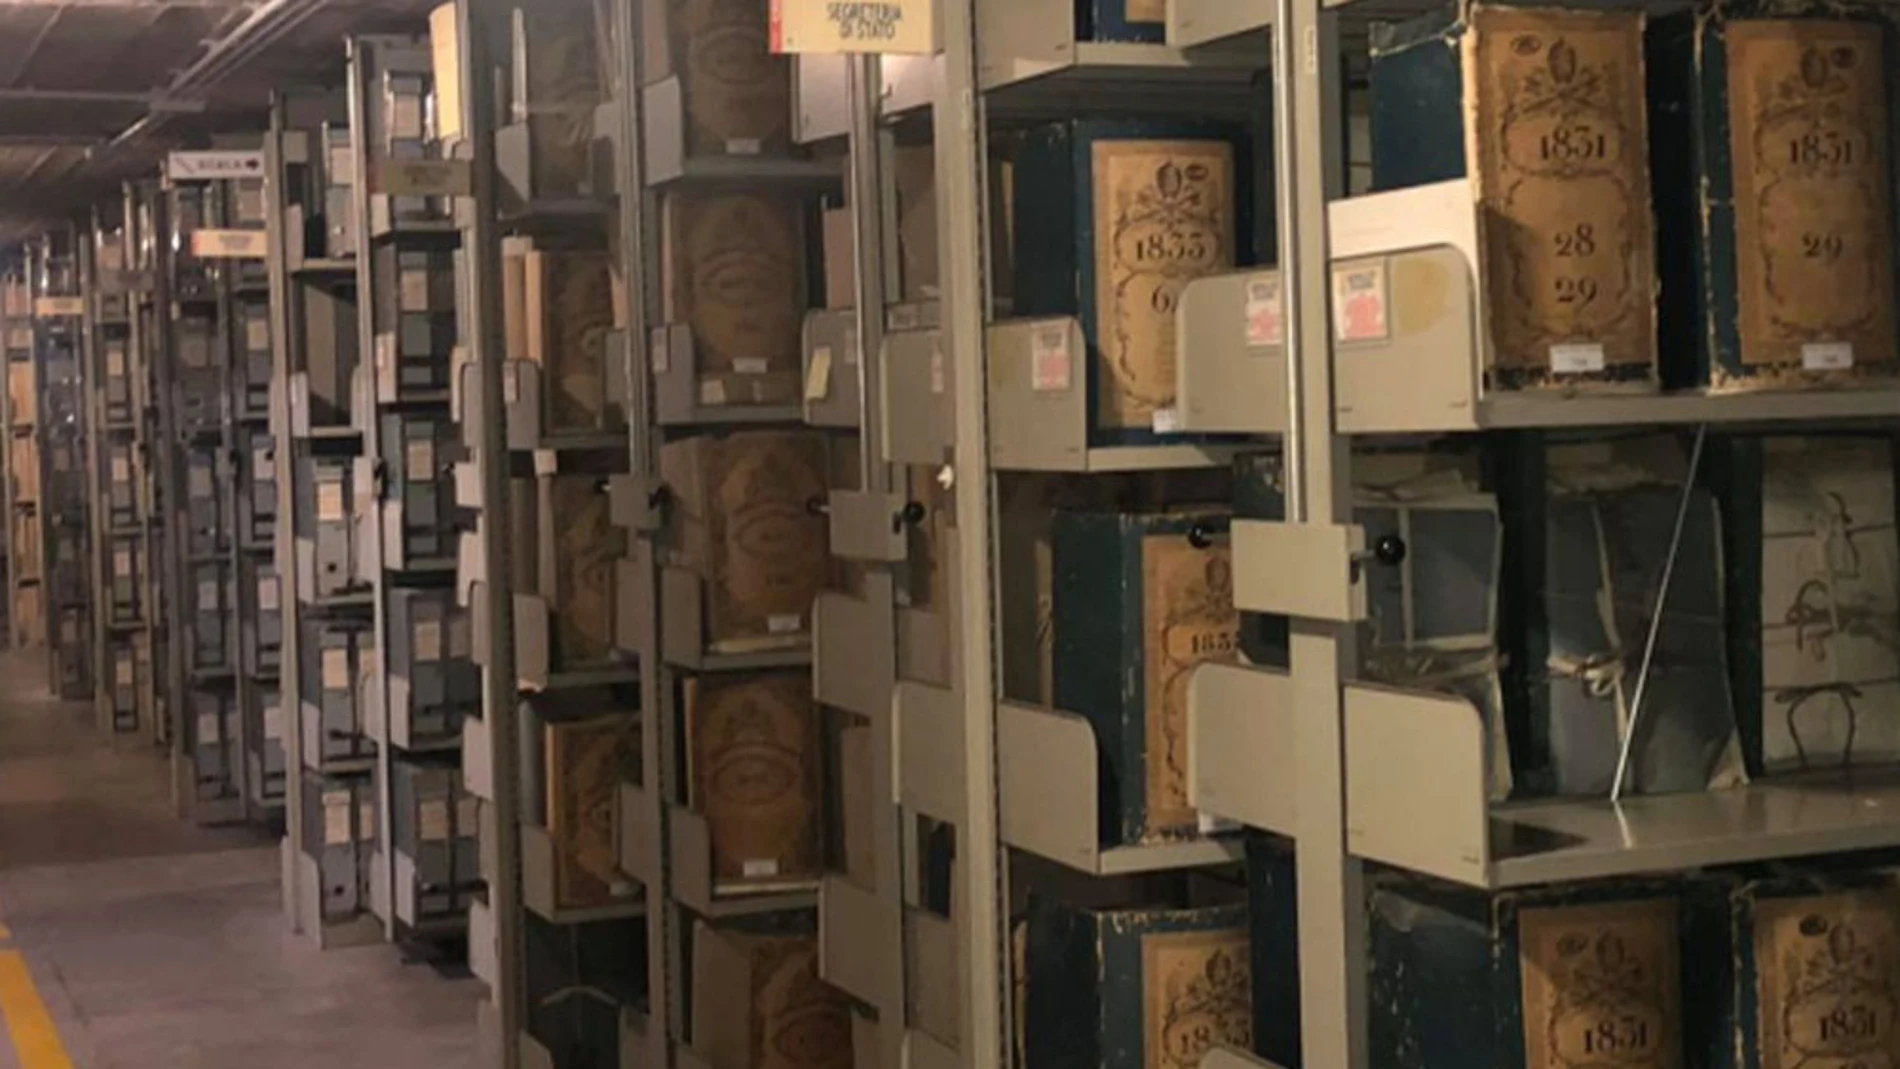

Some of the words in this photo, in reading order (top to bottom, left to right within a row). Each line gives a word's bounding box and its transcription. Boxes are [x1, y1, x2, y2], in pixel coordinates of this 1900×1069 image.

[827, 2, 902, 21] SEGRETERIA
[839, 20, 852, 39] DI
[857, 19, 896, 40] STATO
[1541, 125, 1606, 160] 1831
[1790, 131, 1852, 165] 1831
[1136, 231, 1206, 262] 1833
[1554, 222, 1596, 258] 28
[1802, 231, 1843, 260] 29
[1555, 275, 1598, 317] 29
[1583, 1015, 1648, 1055] 1831
[1820, 1004, 1877, 1042] 1831
